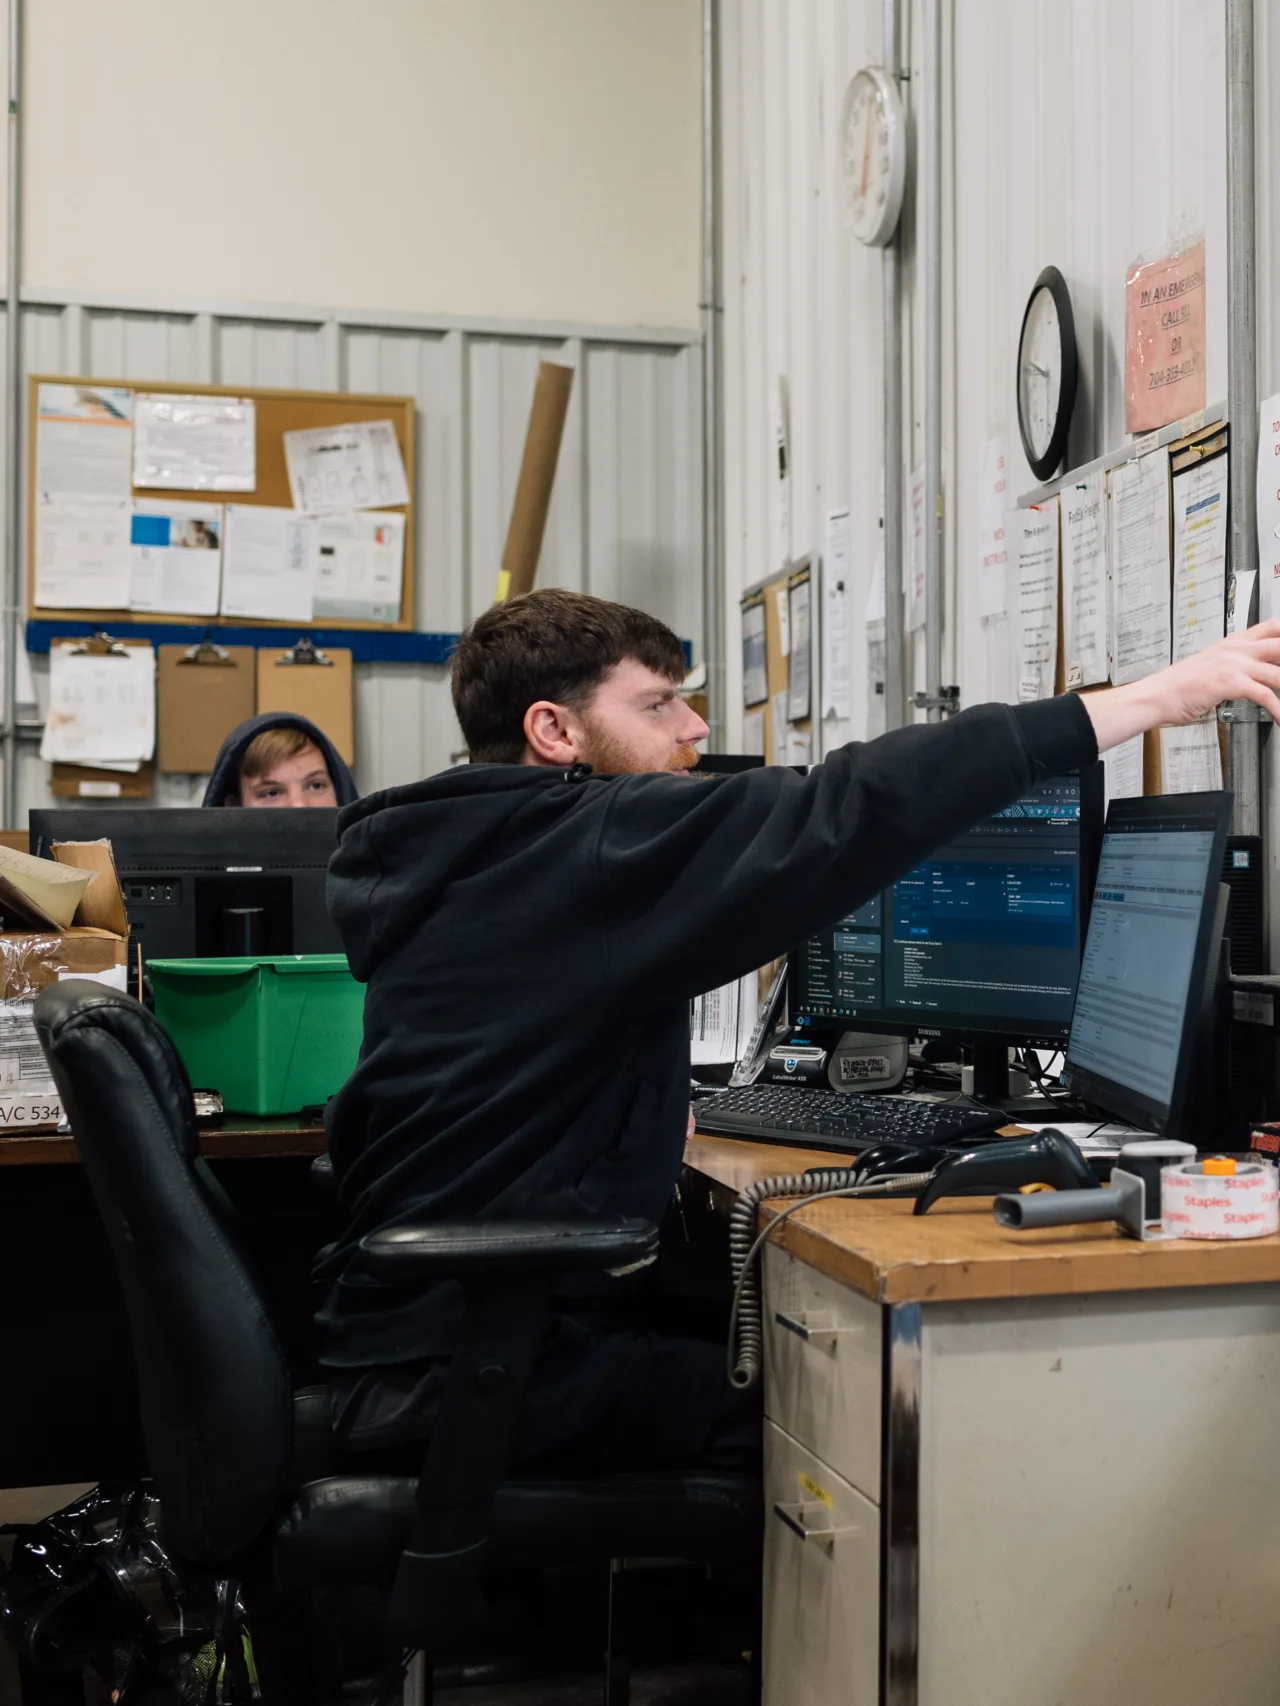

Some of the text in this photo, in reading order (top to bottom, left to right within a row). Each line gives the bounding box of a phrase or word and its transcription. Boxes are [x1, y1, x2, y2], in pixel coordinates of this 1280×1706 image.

[1141, 291, 1151, 304] IN
[1153, 286, 1166, 300] AN
[1161, 309, 1179, 327] CALL
[1171, 336, 1182, 351] OR
[31, 1105, 61, 1121] 534
[1251, 1133, 1280, 1153] TURBO
[1183, 1195, 1231, 1209] Staples
